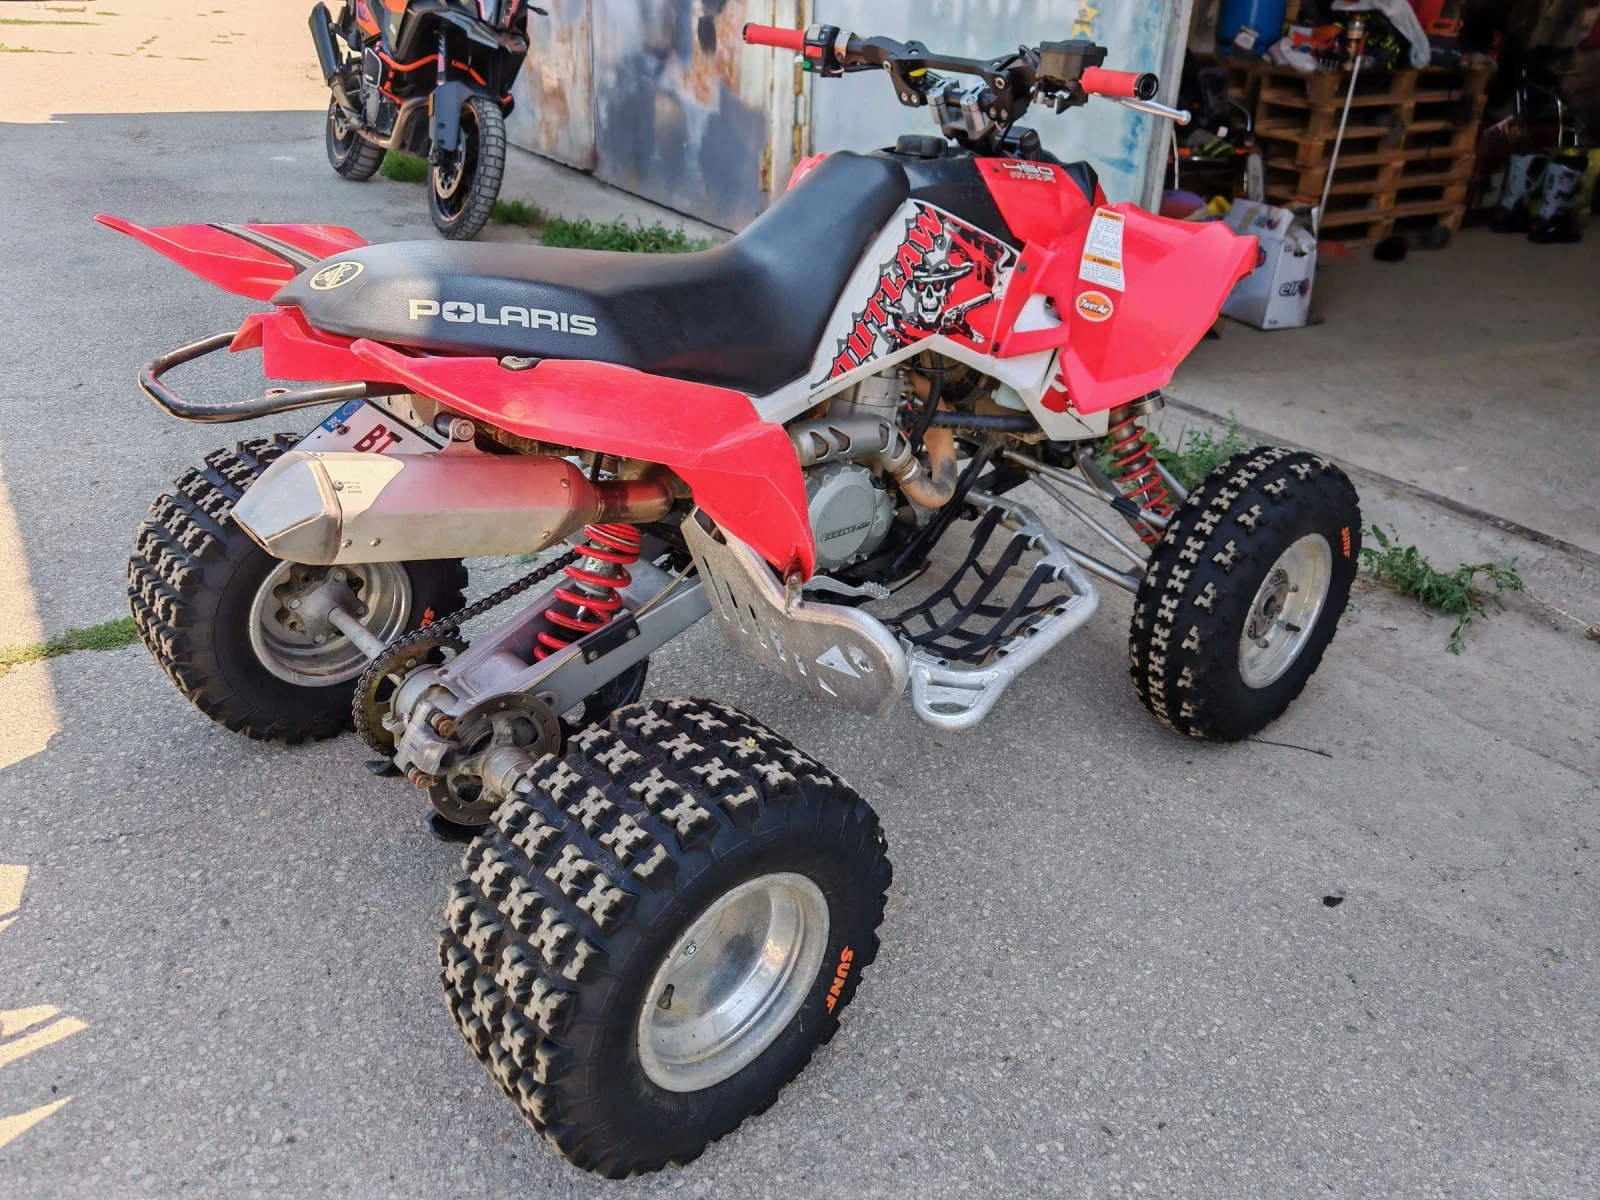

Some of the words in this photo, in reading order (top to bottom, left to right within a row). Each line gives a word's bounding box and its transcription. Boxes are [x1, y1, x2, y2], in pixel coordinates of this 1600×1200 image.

[1002, 162, 1054, 176] 450
[831, 205, 944, 379] OUTLAW
[1080, 298, 1098, 312] Twin
[1096, 304, 1110, 314] Air
[409, 299, 598, 336] POLARIS
[353, 423, 403, 453] BT
[420, 606, 435, 628] SU
[826, 945, 854, 1015] SUNF
